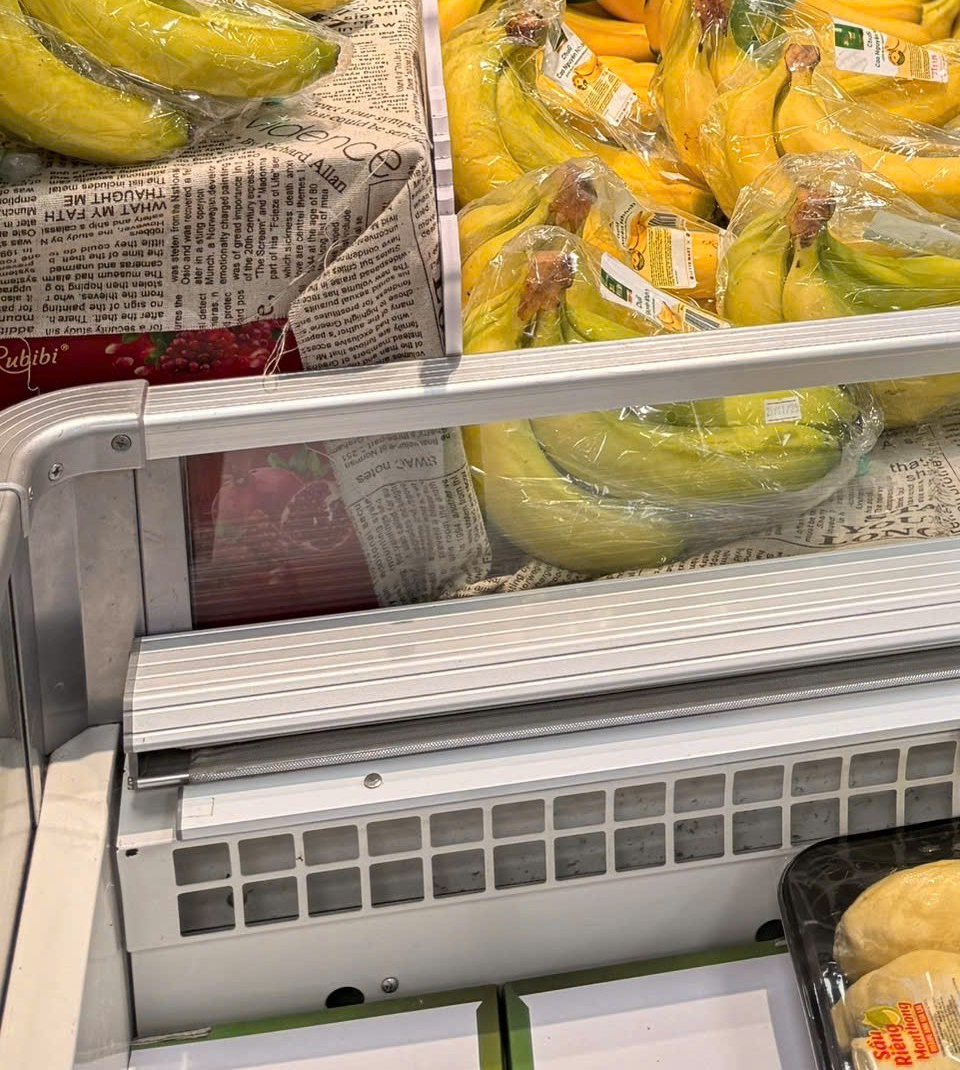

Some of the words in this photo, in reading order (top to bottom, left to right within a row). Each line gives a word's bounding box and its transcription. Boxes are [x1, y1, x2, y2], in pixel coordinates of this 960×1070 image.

[146, 177, 164, 185] The
[308, 158, 348, 194] Allan
[48, 184, 77, 193] metal
[81, 180, 124, 190] includes
[128, 179, 143, 187] list
[309, 183, 317, 193] 80
[90, 187, 164, 204] THAUGHT
[234, 176, 242, 219] importance
[285, 182, 293, 205] death
[63, 194, 85, 206] ME
[309, 196, 317, 205] of
[90, 205, 113, 218] MY
[120, 200, 166, 215] WHAT
[220, 197, 230, 228] charged
[44, 208, 84, 221] FATH
[246, 201, 255, 232] century
[309, 208, 318, 225] age
[318, 211, 327, 219] of
[66, 231, 93, 240] study
[129, 227, 164, 236] robbers
[195, 222, 204, 243] sting
[308, 228, 316, 241] the
[80, 243, 109, 252] could
[114, 240, 136, 248] they
[141, 238, 164, 247] little
[244, 235, 252, 253] 20th
[308, 244, 315, 252] at
[89, 252, 104, 260] the
[107, 250, 117, 258] of
[144, 248, 162, 257] the
[182, 245, 190, 261] and
[219, 231, 229, 283] emotionally
[232, 250, 240, 259] of
[269, 252, 276, 260] of
[195, 255, 202, 263] in
[244, 257, 252, 270] the
[359, 257, 373, 268] but
[49, 263, 93, 273] unarmed
[269, 263, 278, 279] part
[282, 255, 290, 278] which
[392, 261, 409, 272] The
[144, 270, 162, 278] The
[374, 268, 391, 280] new
[68, 282, 102, 290] hoping
[106, 281, 127, 289] then
[132, 280, 162, 288] stolen
[340, 279, 373, 294] volume
[53, 293, 74, 301] who
[236, 289, 246, 305] pos
[322, 290, 339, 299] has
[341, 290, 369, 303] sexual
[109, 302, 118, 310] of
[123, 300, 146, 308] sign
[150, 300, 163, 308] no
[174, 294, 182, 307] the
[198, 293, 206, 319] detect
[223, 291, 233, 318] protec
[303, 298, 339, 313] pursuits
[361, 298, 373, 307] for
[390, 299, 414, 310] many
[42, 302, 84, 312] painting
[89, 303, 105, 311] the
[313, 303, 359, 321] prostitutes
[140, 311, 163, 319] after
[391, 312, 409, 321] who
[393, 320, 417, 331] family
[333, 329, 373, 347] exclusive
[329, 348, 346, 357] that
[354, 461, 391, 483] notes
[898, 1002, 930, 1059] Monthong
[866, 1031, 891, 1060] Sầu
[886, 1024, 912, 1066] Riêng
